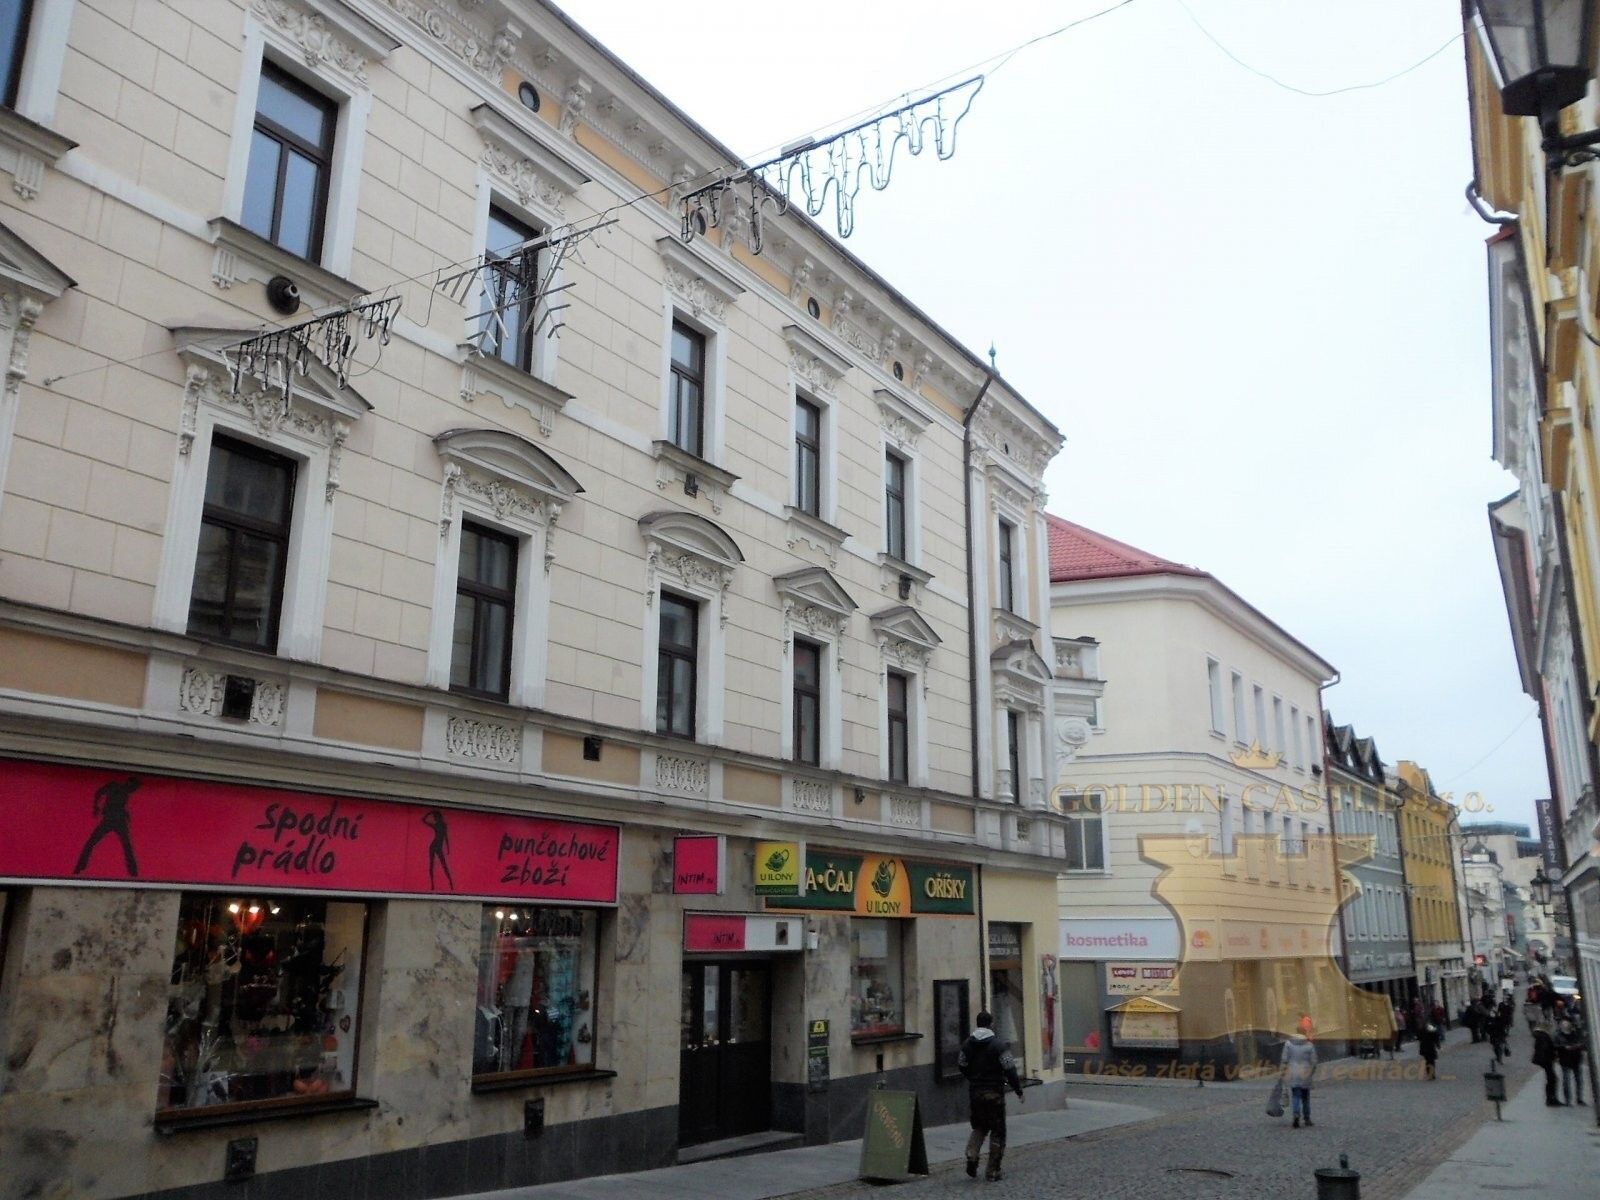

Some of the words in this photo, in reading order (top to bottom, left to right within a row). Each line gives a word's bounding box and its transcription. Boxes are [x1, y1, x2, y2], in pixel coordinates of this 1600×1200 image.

[255, 800, 364, 842] spodní
[231, 834, 335, 878] prádlo
[498, 832, 610, 861] punčochové
[500, 857, 570, 887] zboží
[768, 873, 793, 881] ILONY
[925, 873, 966, 899] OŘÍŠKY
[866, 901, 873, 914] U
[875, 901, 900, 914] ILONY
[1066, 932, 1148, 947] kosmetika
